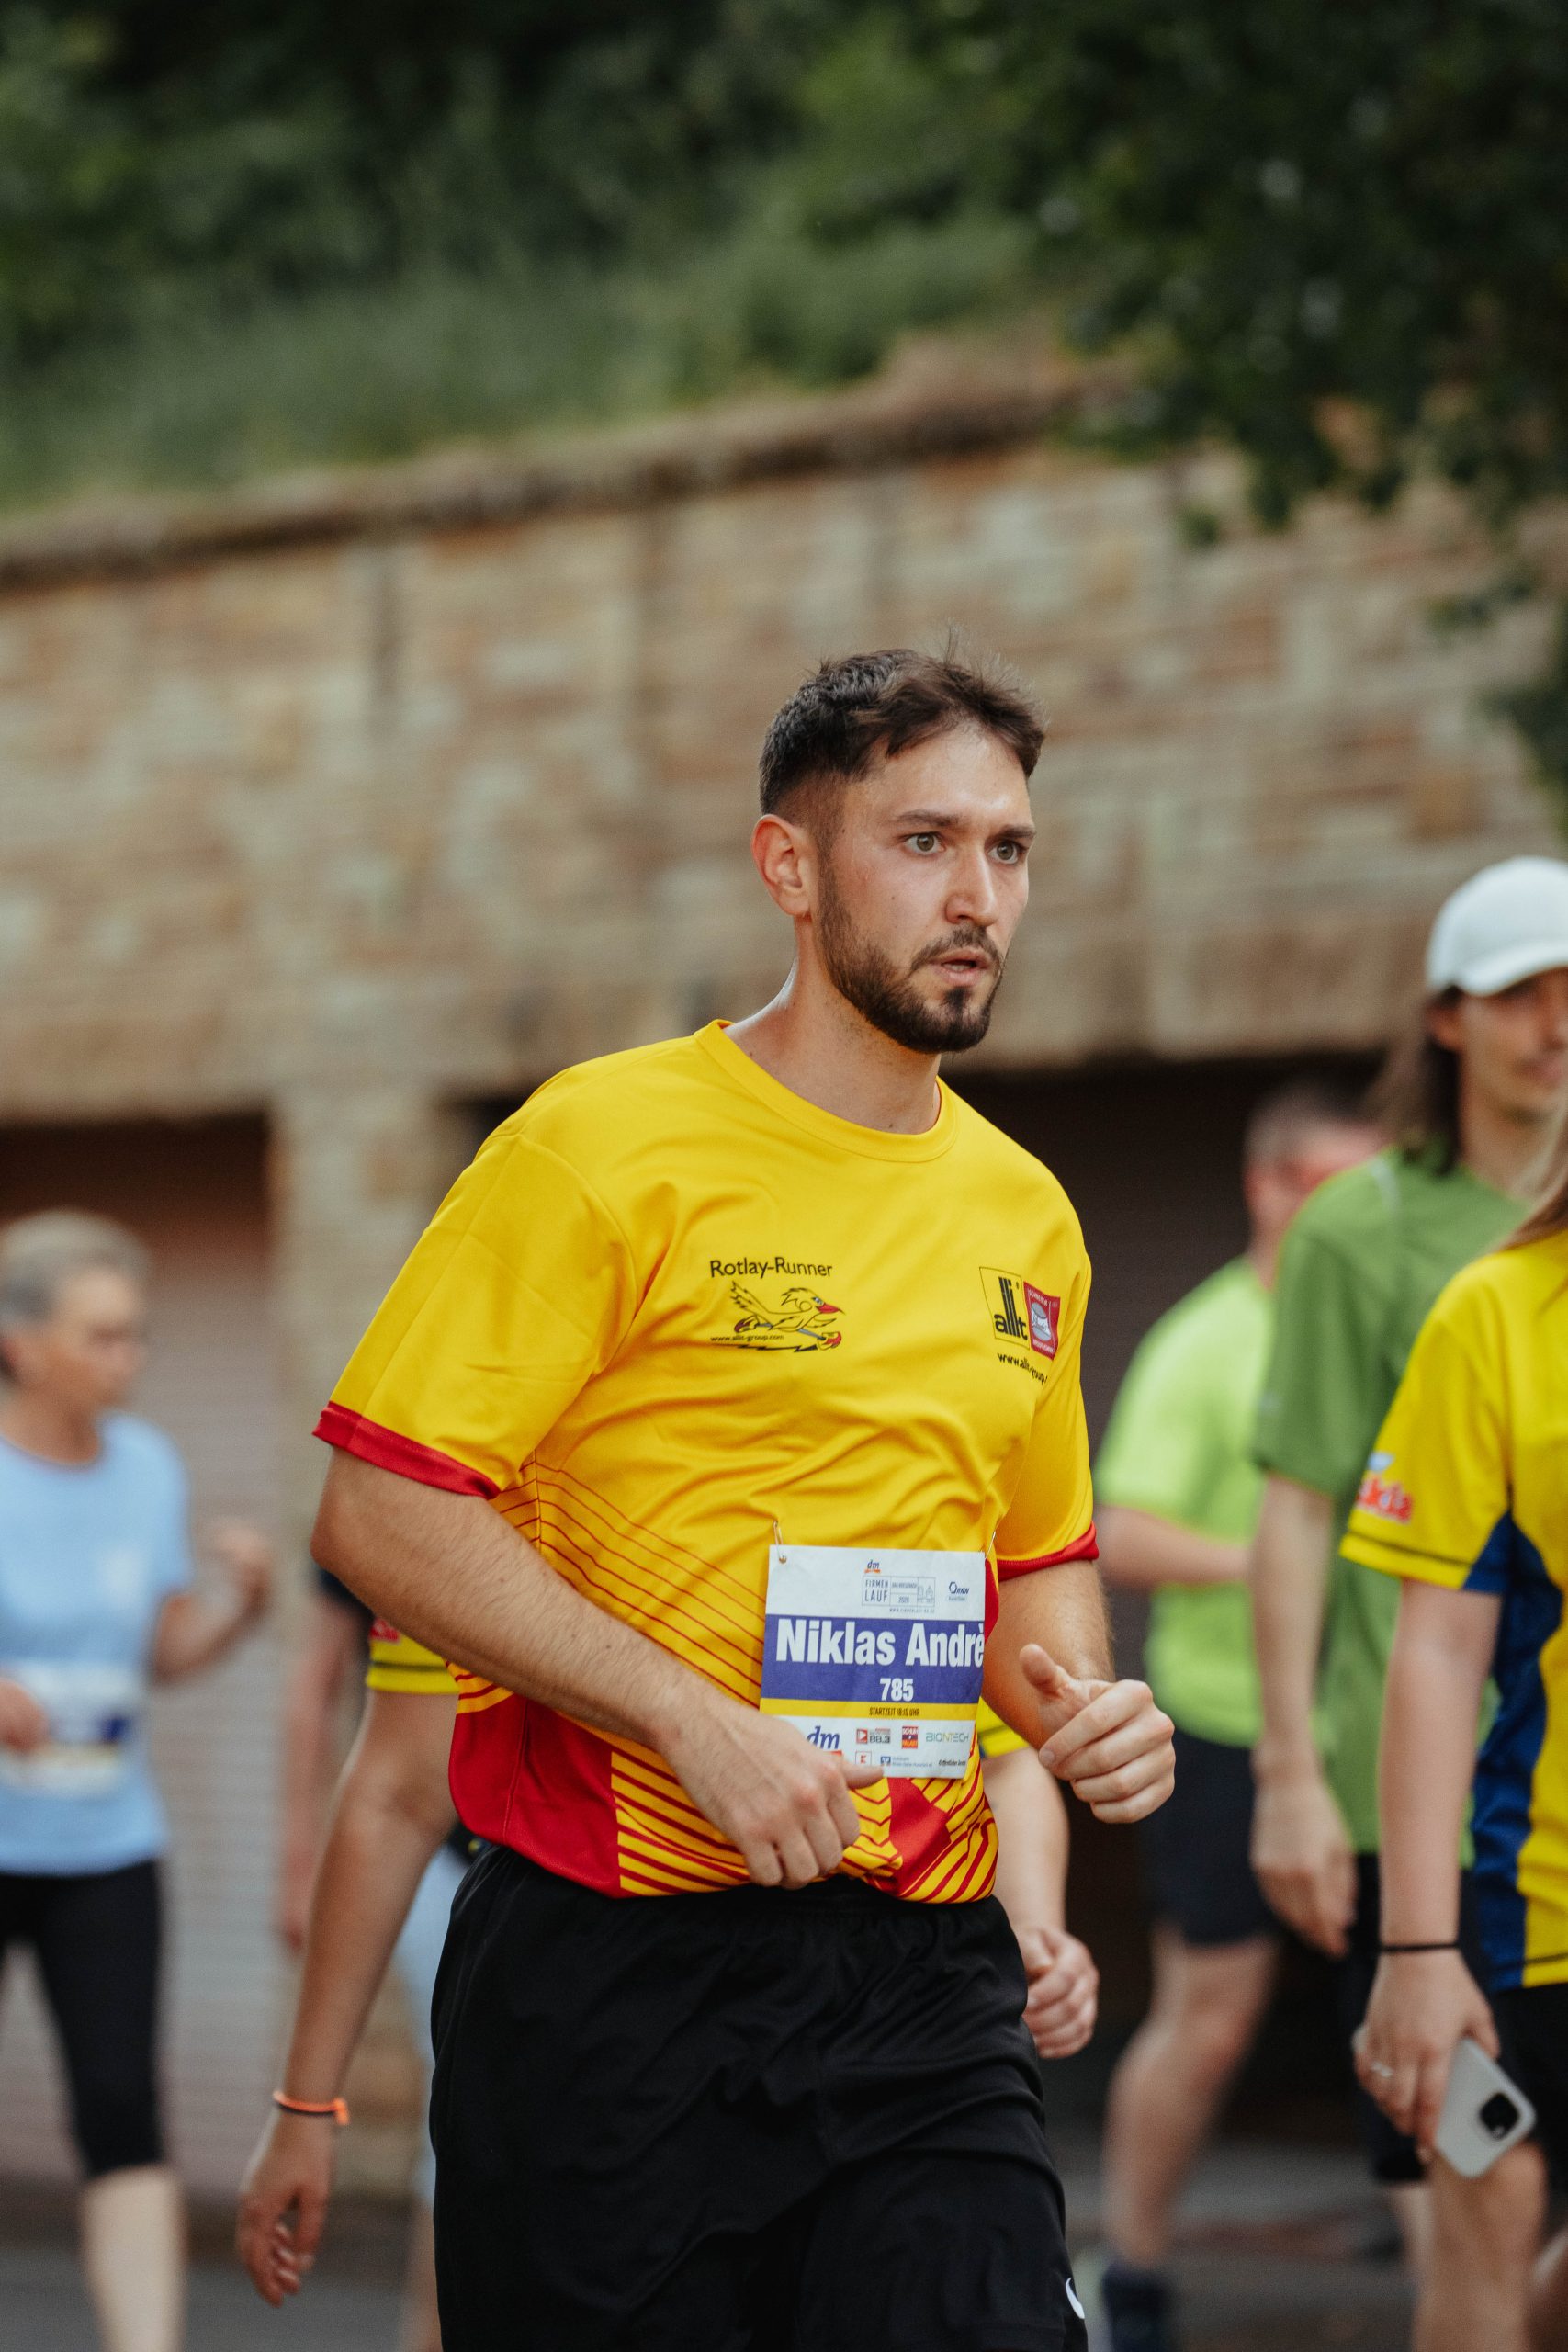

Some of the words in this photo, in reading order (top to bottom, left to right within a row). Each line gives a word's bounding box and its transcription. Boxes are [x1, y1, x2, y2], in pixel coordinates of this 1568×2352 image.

[710, 1257, 833, 1279] Rotlay-Runner
[867, 1559, 879, 1569] dm
[865, 1579, 889, 1589] FIRMEN
[864, 1589, 887, 1603] LAUF
[775, 1618, 896, 1666] Niklas
[879, 1678, 914, 1702] 785
[869, 1706, 896, 1716] STARTZEIT
[909, 1708, 919, 1717] UHR
[807, 1725, 840, 1749] dm
[925, 1732, 969, 1743] BIONTECH
